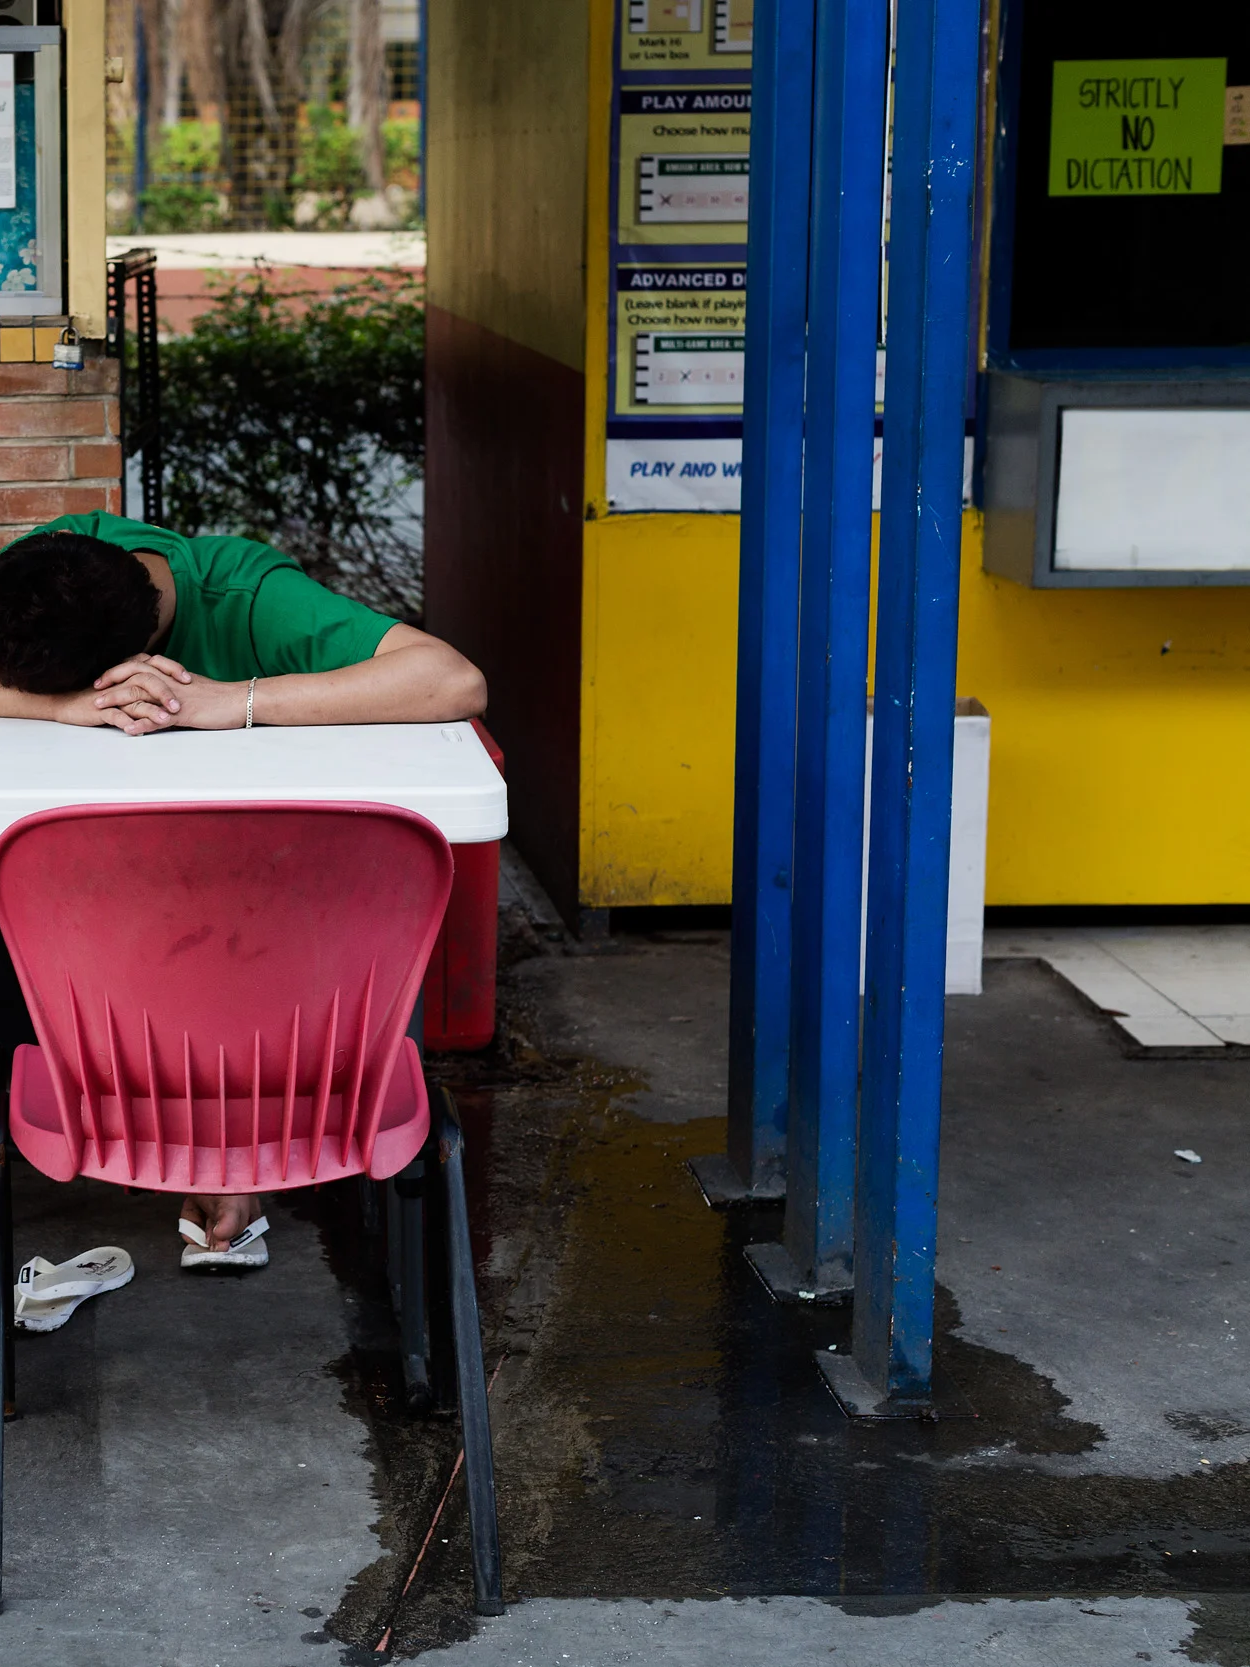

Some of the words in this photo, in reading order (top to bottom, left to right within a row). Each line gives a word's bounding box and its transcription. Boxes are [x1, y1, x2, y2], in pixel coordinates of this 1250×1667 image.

[1079, 77, 1185, 109] STRICTLY
[641, 95, 688, 109] PLAY
[653, 124, 698, 137] Choose
[700, 124, 729, 136] how
[1121, 115, 1155, 152] NO
[1067, 157, 1192, 191] DICTATION
[630, 273, 727, 287] ADVANCED
[731, 273, 746, 286] D
[625, 298, 663, 311] (Leave
[666, 298, 699, 309] blank
[702, 298, 712, 309] if
[627, 315, 671, 325] Choose
[674, 315, 701, 325] how
[704, 316, 739, 327] many
[630, 461, 675, 478] PLAY
[679, 461, 717, 478] AND
